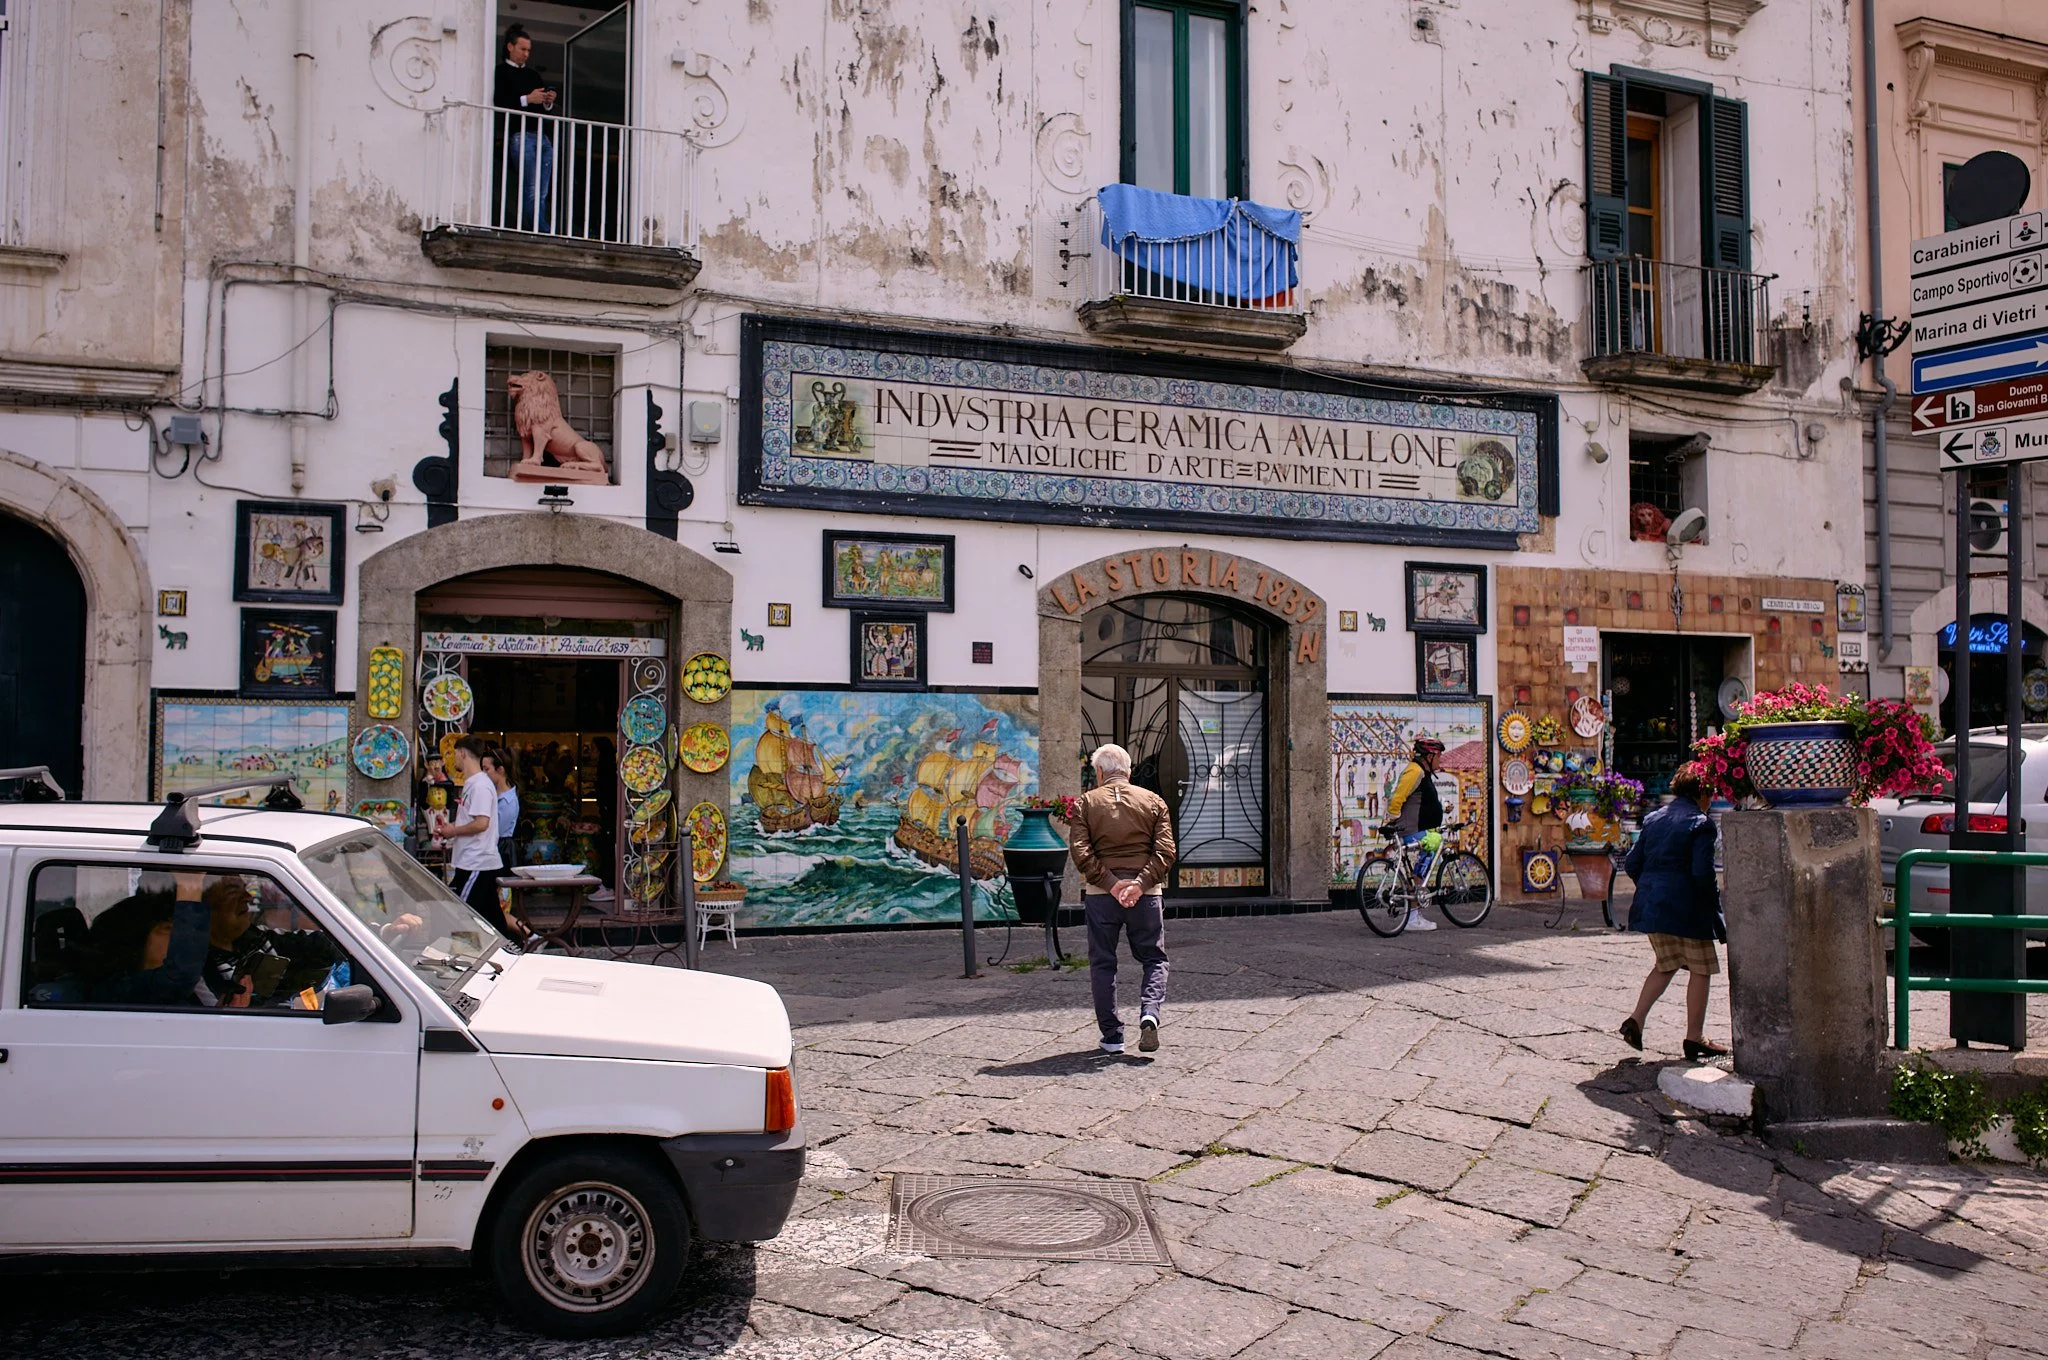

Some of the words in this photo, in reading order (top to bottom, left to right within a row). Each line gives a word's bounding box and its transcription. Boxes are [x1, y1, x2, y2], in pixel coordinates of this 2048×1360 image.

[1913, 230, 2001, 264] Carabinieri
[1913, 283, 1954, 302] Campo
[1957, 270, 2009, 296] Sportivo
[1915, 320, 1967, 342] Marina
[1972, 314, 1988, 331] di
[1992, 304, 2037, 327] Vietri
[1977, 404, 1995, 413] San
[1997, 395, 2038, 411] Giovanni
[2040, 394, 2048, 404] B
[2009, 384, 2043, 396] Duomo
[875, 388, 1076, 441] INDVSTRIA
[1085, 406, 1273, 454] CERAMICA
[1283, 424, 1458, 469] AVALLONE
[989, 441, 1127, 472] MAIOLICHE
[1147, 453, 1235, 480] D'ARTE
[1256, 461, 1372, 490] PAVIMENTI
[1050, 572, 1098, 615] LA
[1104, 552, 1239, 592] STORIA
[1252, 570, 1320, 624] 1839
[609, 643, 630, 654] 1839
